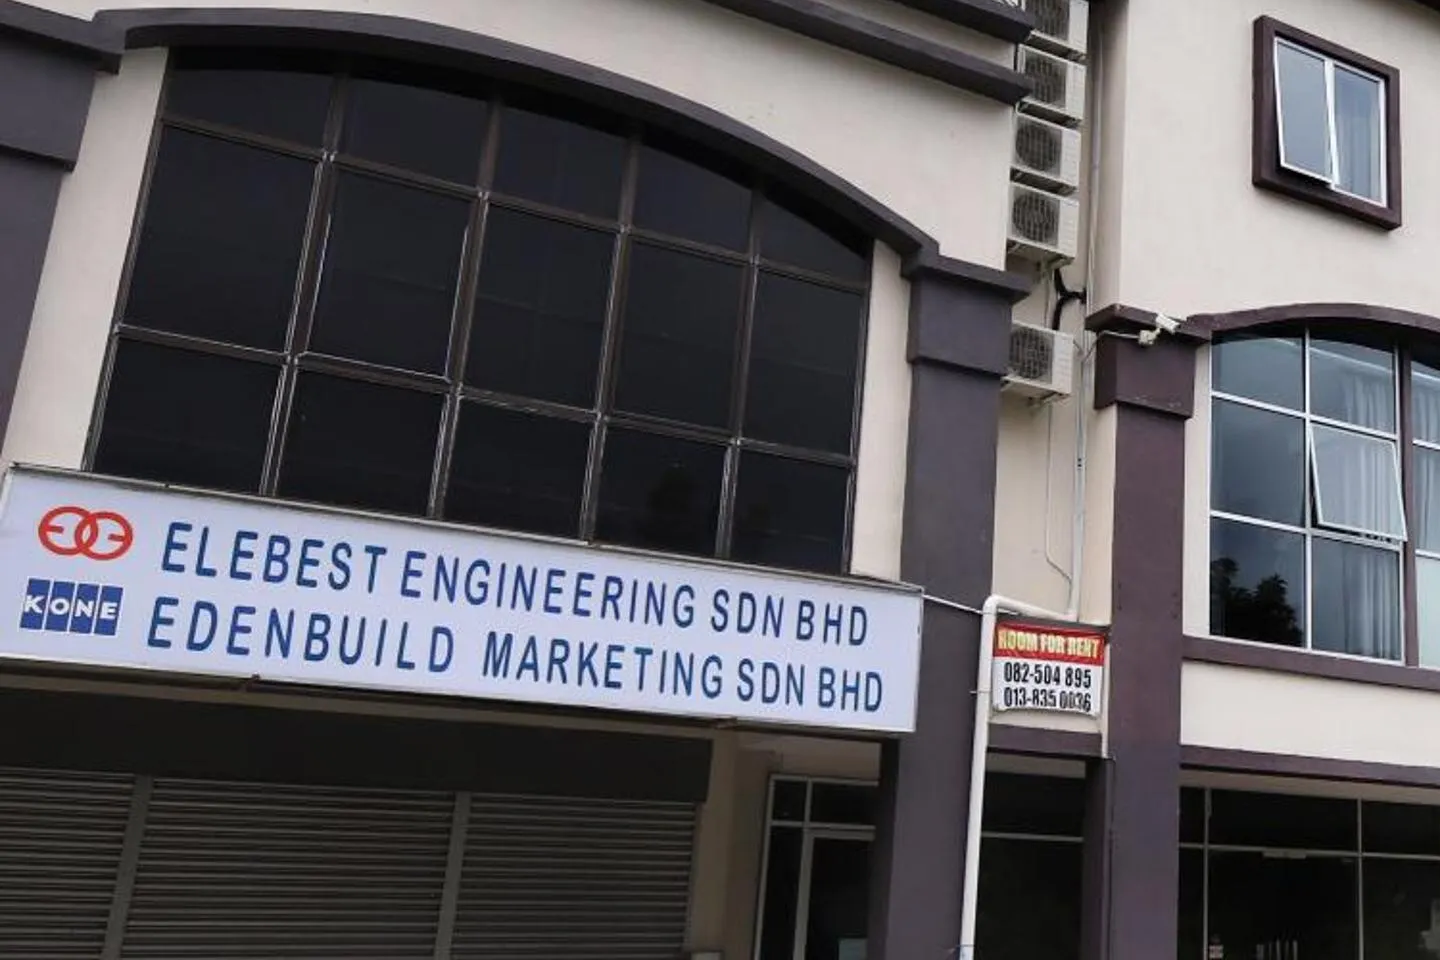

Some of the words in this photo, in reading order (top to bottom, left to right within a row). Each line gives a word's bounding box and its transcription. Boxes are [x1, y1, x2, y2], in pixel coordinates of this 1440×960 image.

[161, 521, 387, 593] ELEBEST
[400, 550, 695, 628] ENGINEERING
[711, 589, 783, 638] SDN
[796, 600, 869, 646] BHD
[147, 596, 455, 673] EDENBUILD
[482, 631, 722, 699] MARKETING
[737, 658, 804, 706] SDN
[818, 667, 883, 712] BHD
[998, 629, 1038, 651] ROOM
[1041, 633, 1064, 653] FOR
[1068, 637, 1100, 658] RENT
[1004, 662, 1060, 685] 082-504
[1065, 667, 1091, 688] 895
[1004, 687, 1057, 707] 013-835
